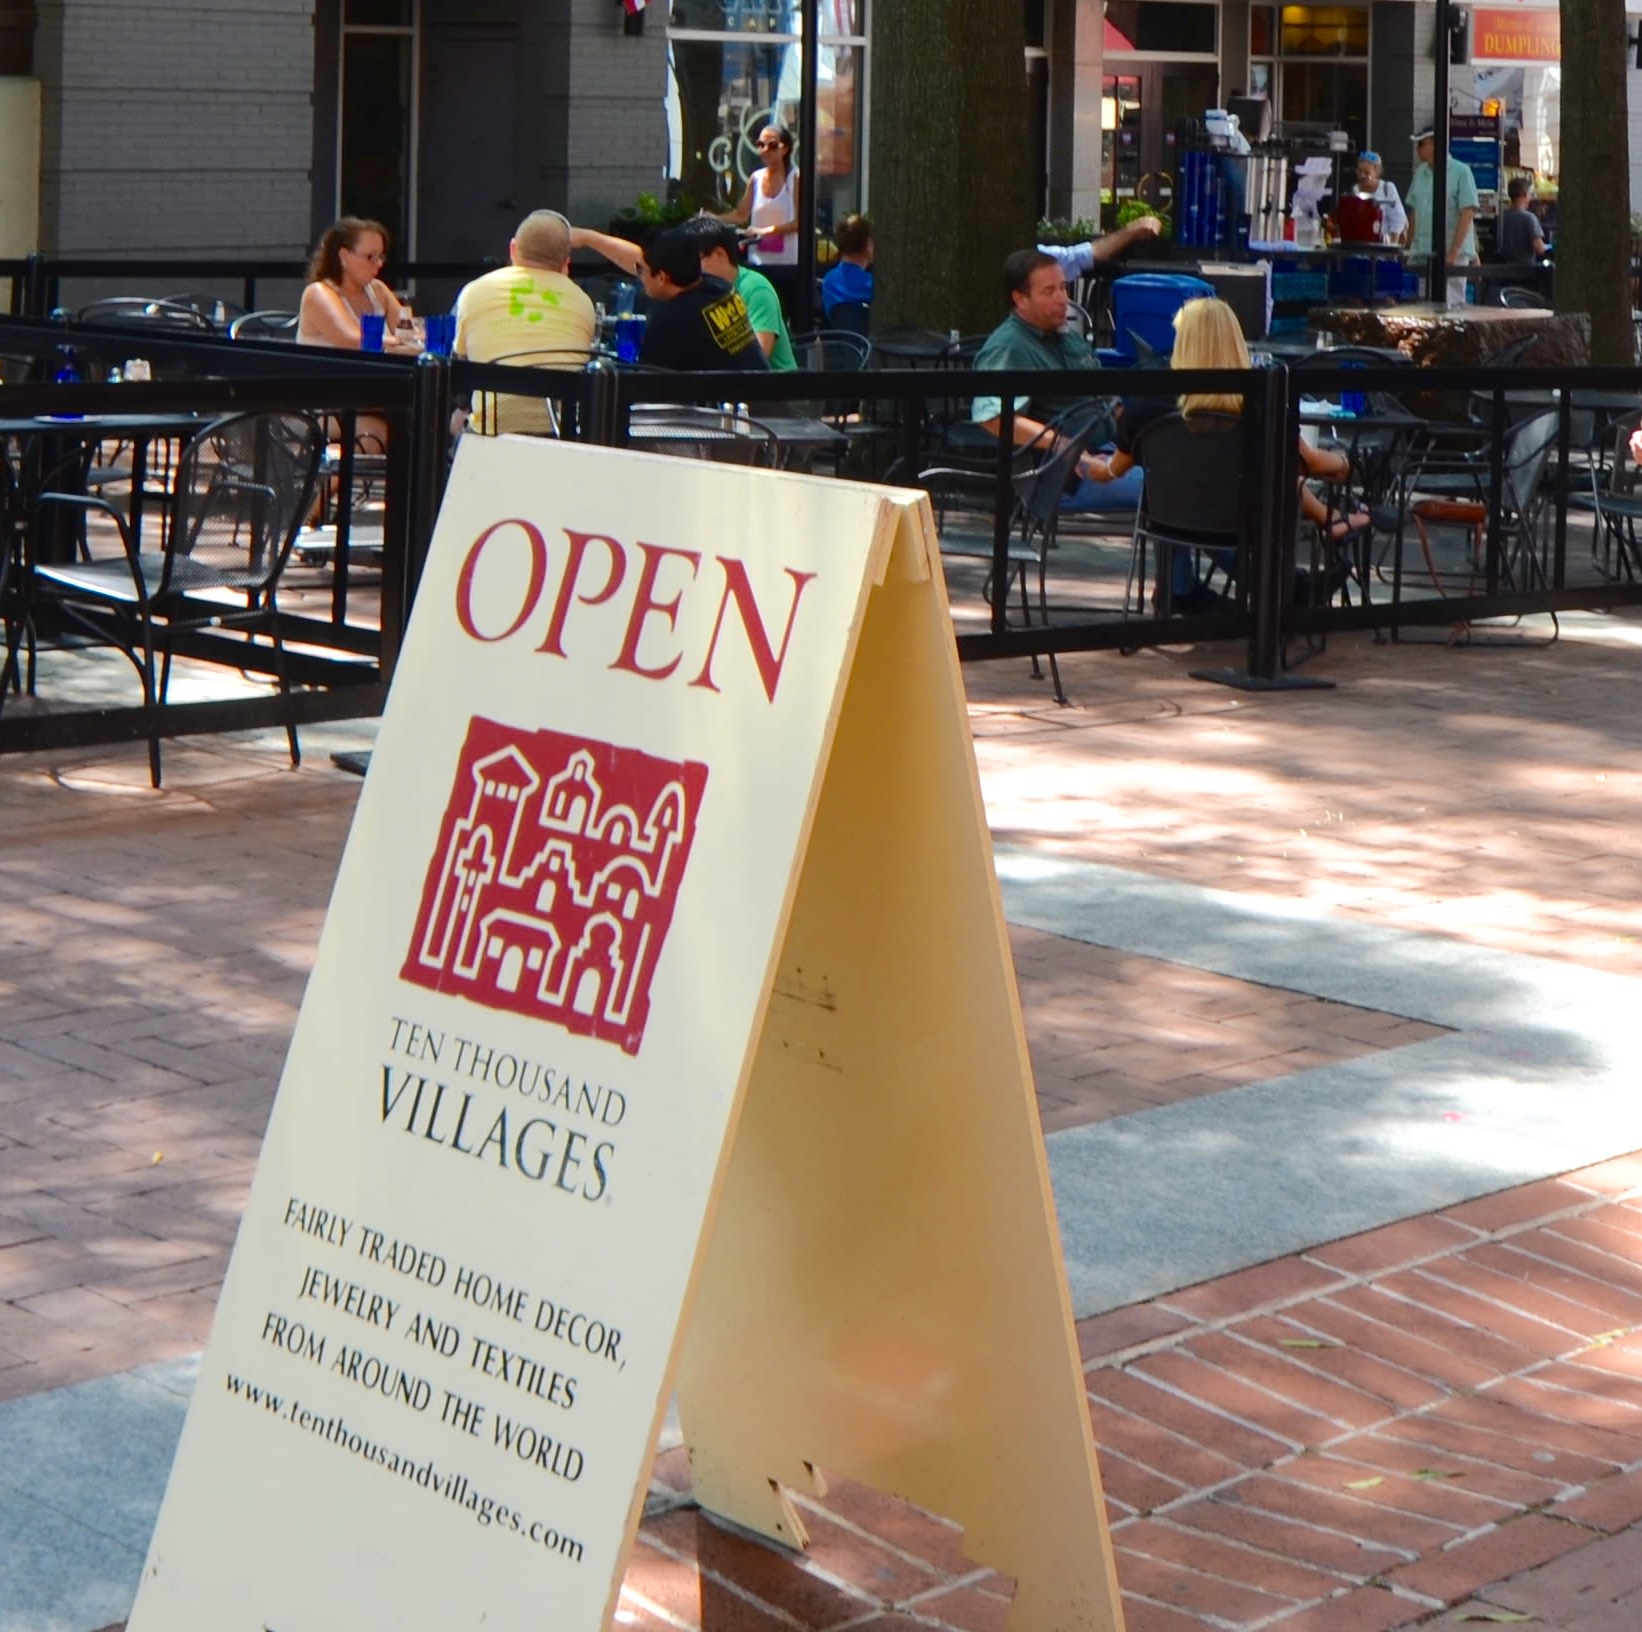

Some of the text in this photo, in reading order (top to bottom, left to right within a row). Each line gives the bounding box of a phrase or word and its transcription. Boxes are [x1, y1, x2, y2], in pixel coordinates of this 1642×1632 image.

[1484, 32, 1561, 59] DUMPLING
[455, 517, 818, 704] OPEN
[380, 1063, 615, 1202] VILLAGES
[391, 1016, 627, 1127] TEN THOUSAND
[283, 1197, 628, 1373] FAIRLY TRADED HOME DECOR,
[297, 1265, 578, 1410] JEWELRY AND TEXTILES
[225, 1372, 586, 1563] www.tenthousandvillages.com
[261, 1311, 585, 1483] FROM AROUND THE WORLD
